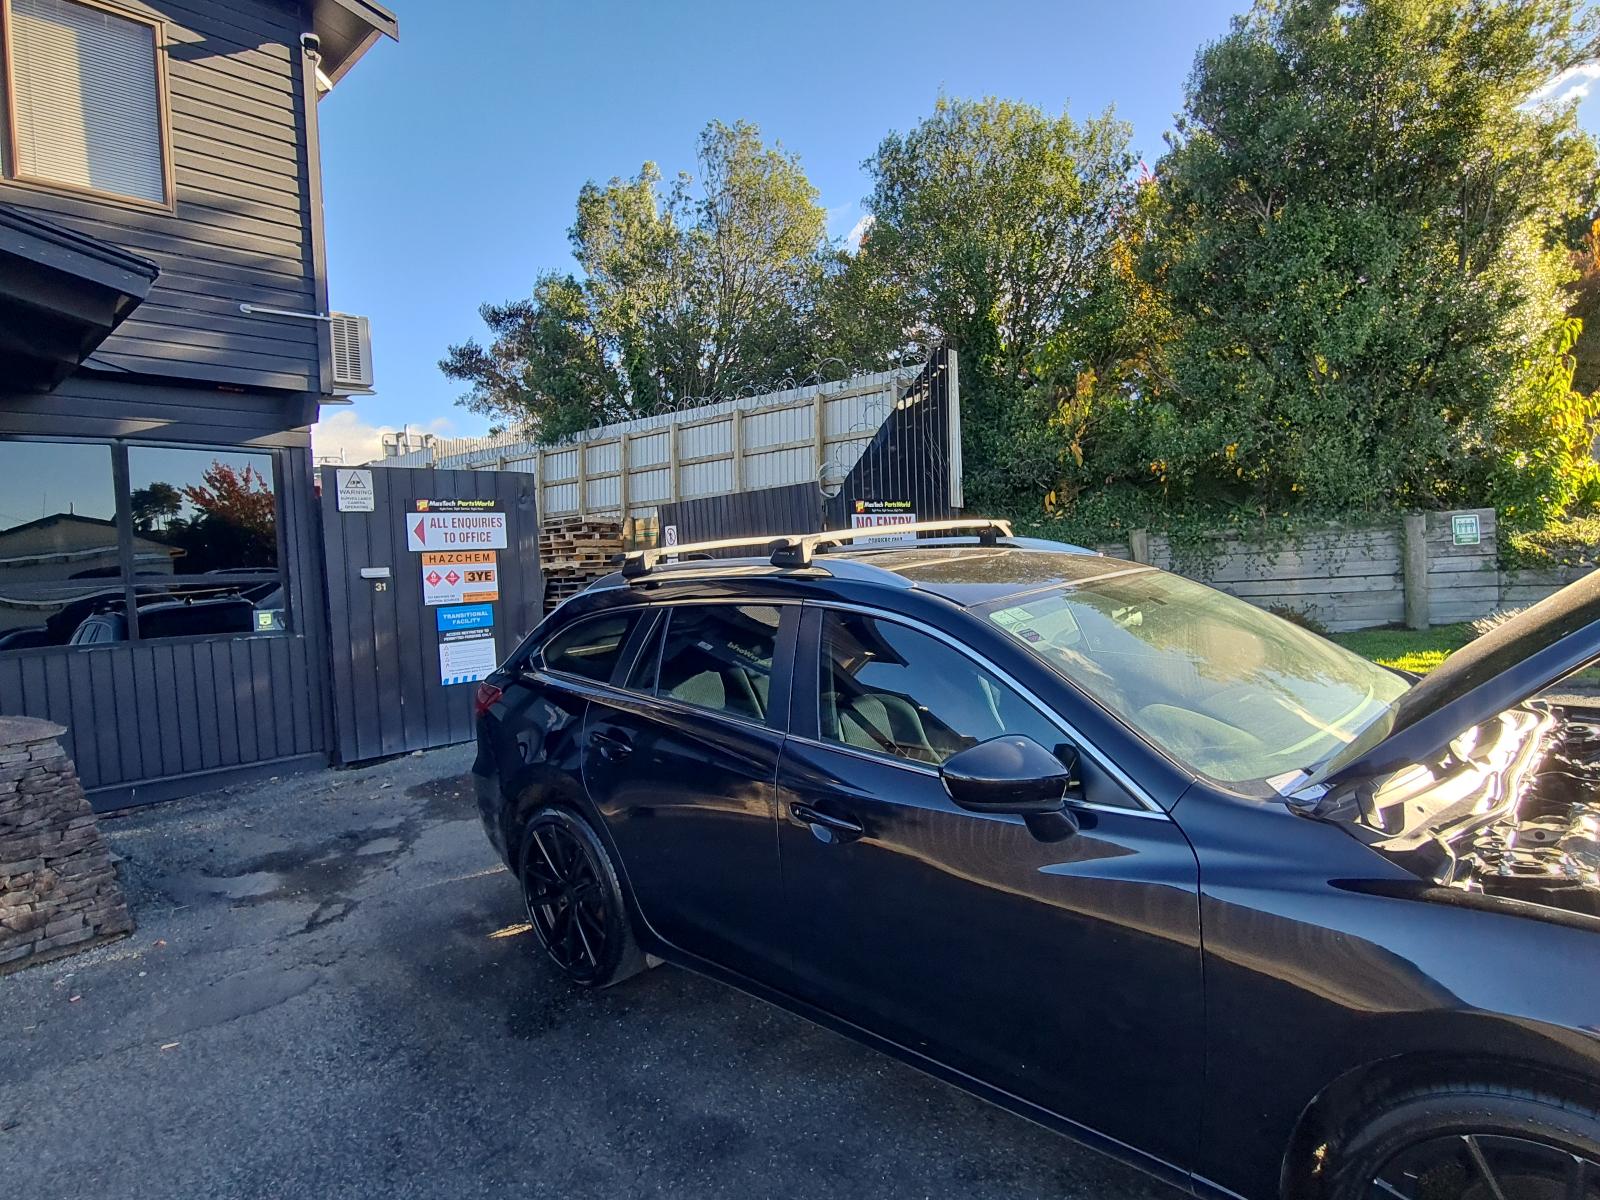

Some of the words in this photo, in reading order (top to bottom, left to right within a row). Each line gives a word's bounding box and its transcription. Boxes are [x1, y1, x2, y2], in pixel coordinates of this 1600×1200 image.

[430, 517, 448, 529] ALL
[451, 517, 503, 529] ENQUIRIES
[856, 516, 873, 528] NO
[443, 532, 455, 543] TO
[459, 532, 492, 543] OFFICE
[429, 553, 490, 563] HAZCHEM
[467, 571, 492, 582] 3YE
[375, 582, 386, 592] 31
[443, 611, 488, 619] TRANSITIONAL
